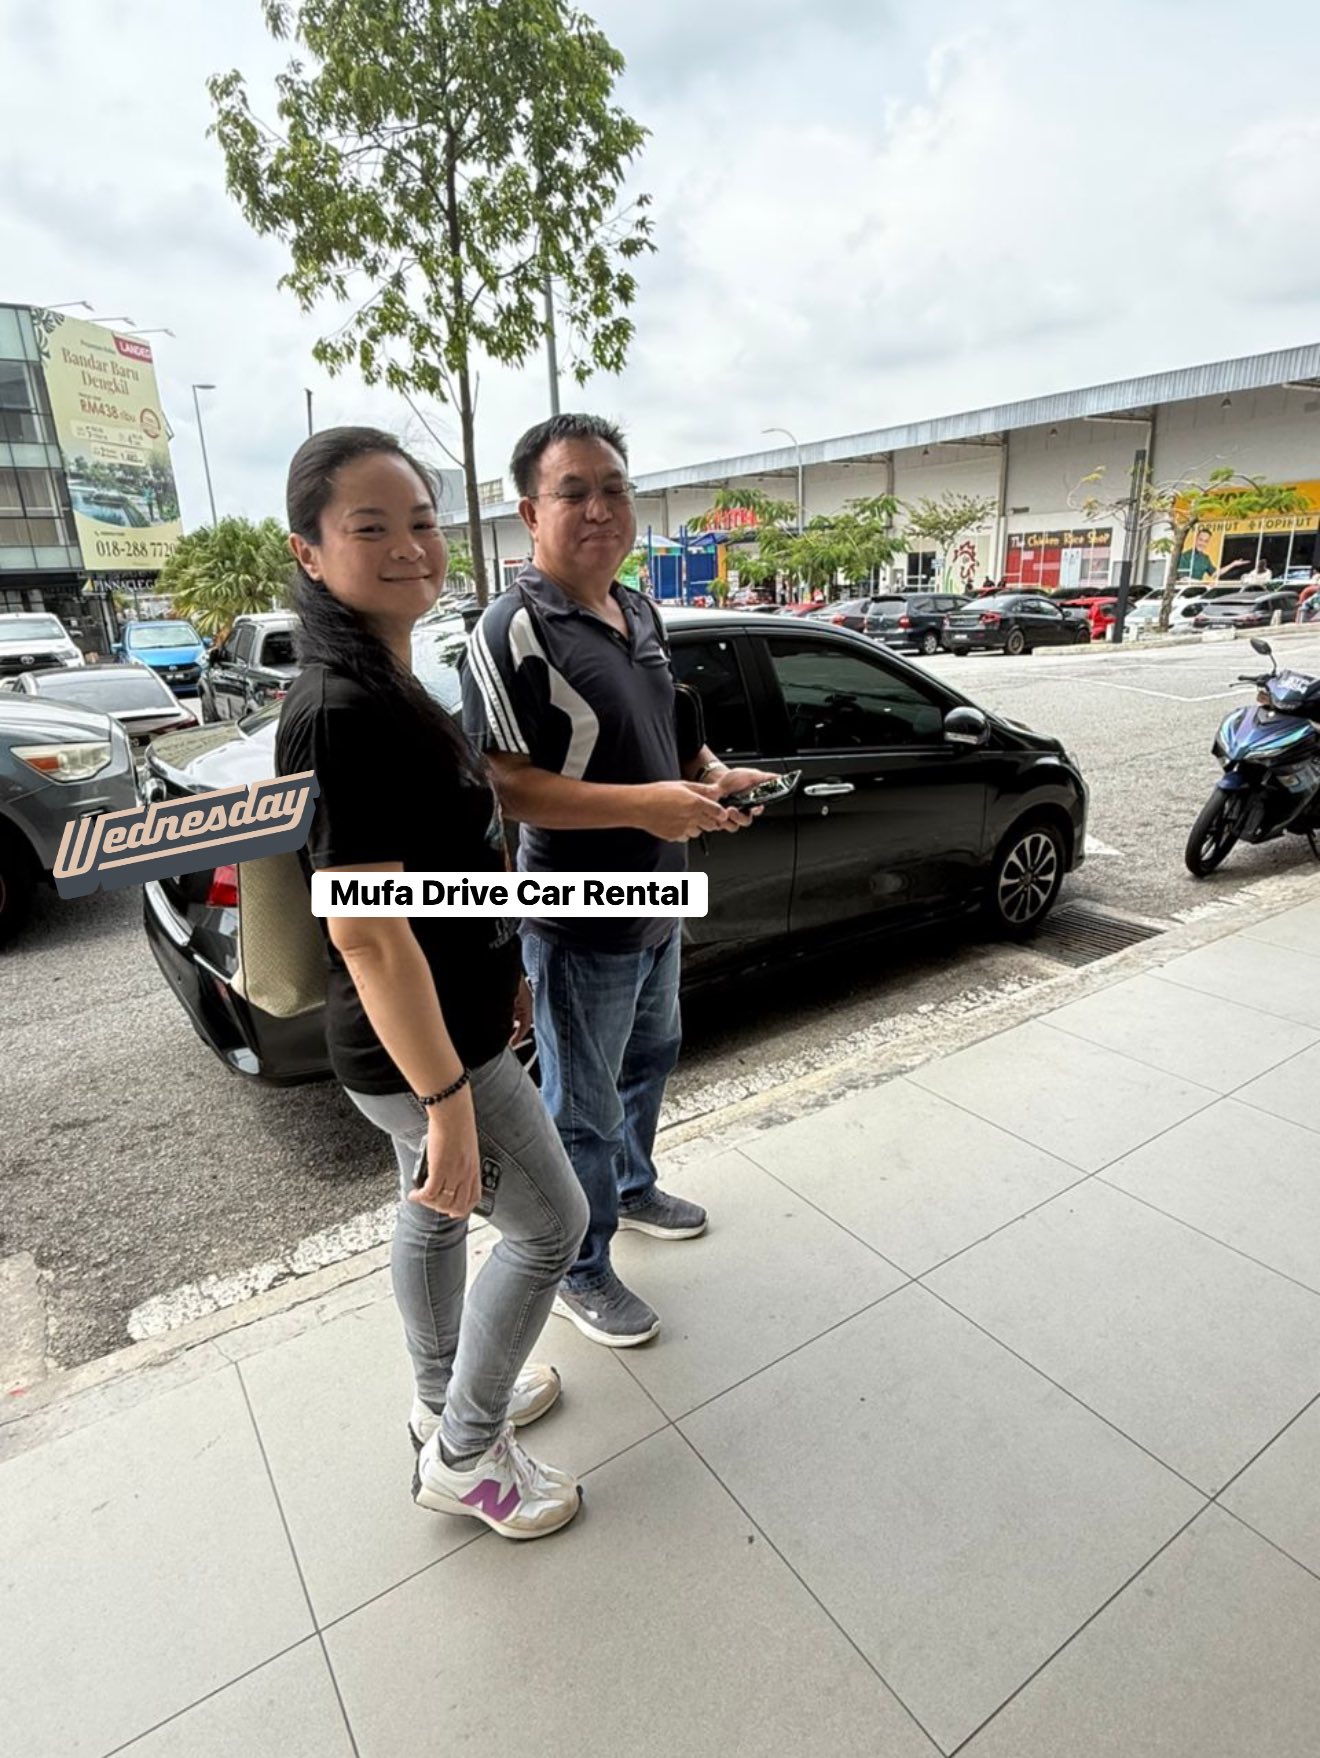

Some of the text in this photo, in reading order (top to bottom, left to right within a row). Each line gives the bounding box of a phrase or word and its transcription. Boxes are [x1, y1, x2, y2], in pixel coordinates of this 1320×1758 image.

[61, 347, 107, 373] Bandar
[110, 360, 139, 381] Baru
[81, 370, 129, 395] Dengkil
[79, 398, 119, 420] RM438
[96, 540, 148, 557] 018-288
[1063, 532, 1085, 546] Rice
